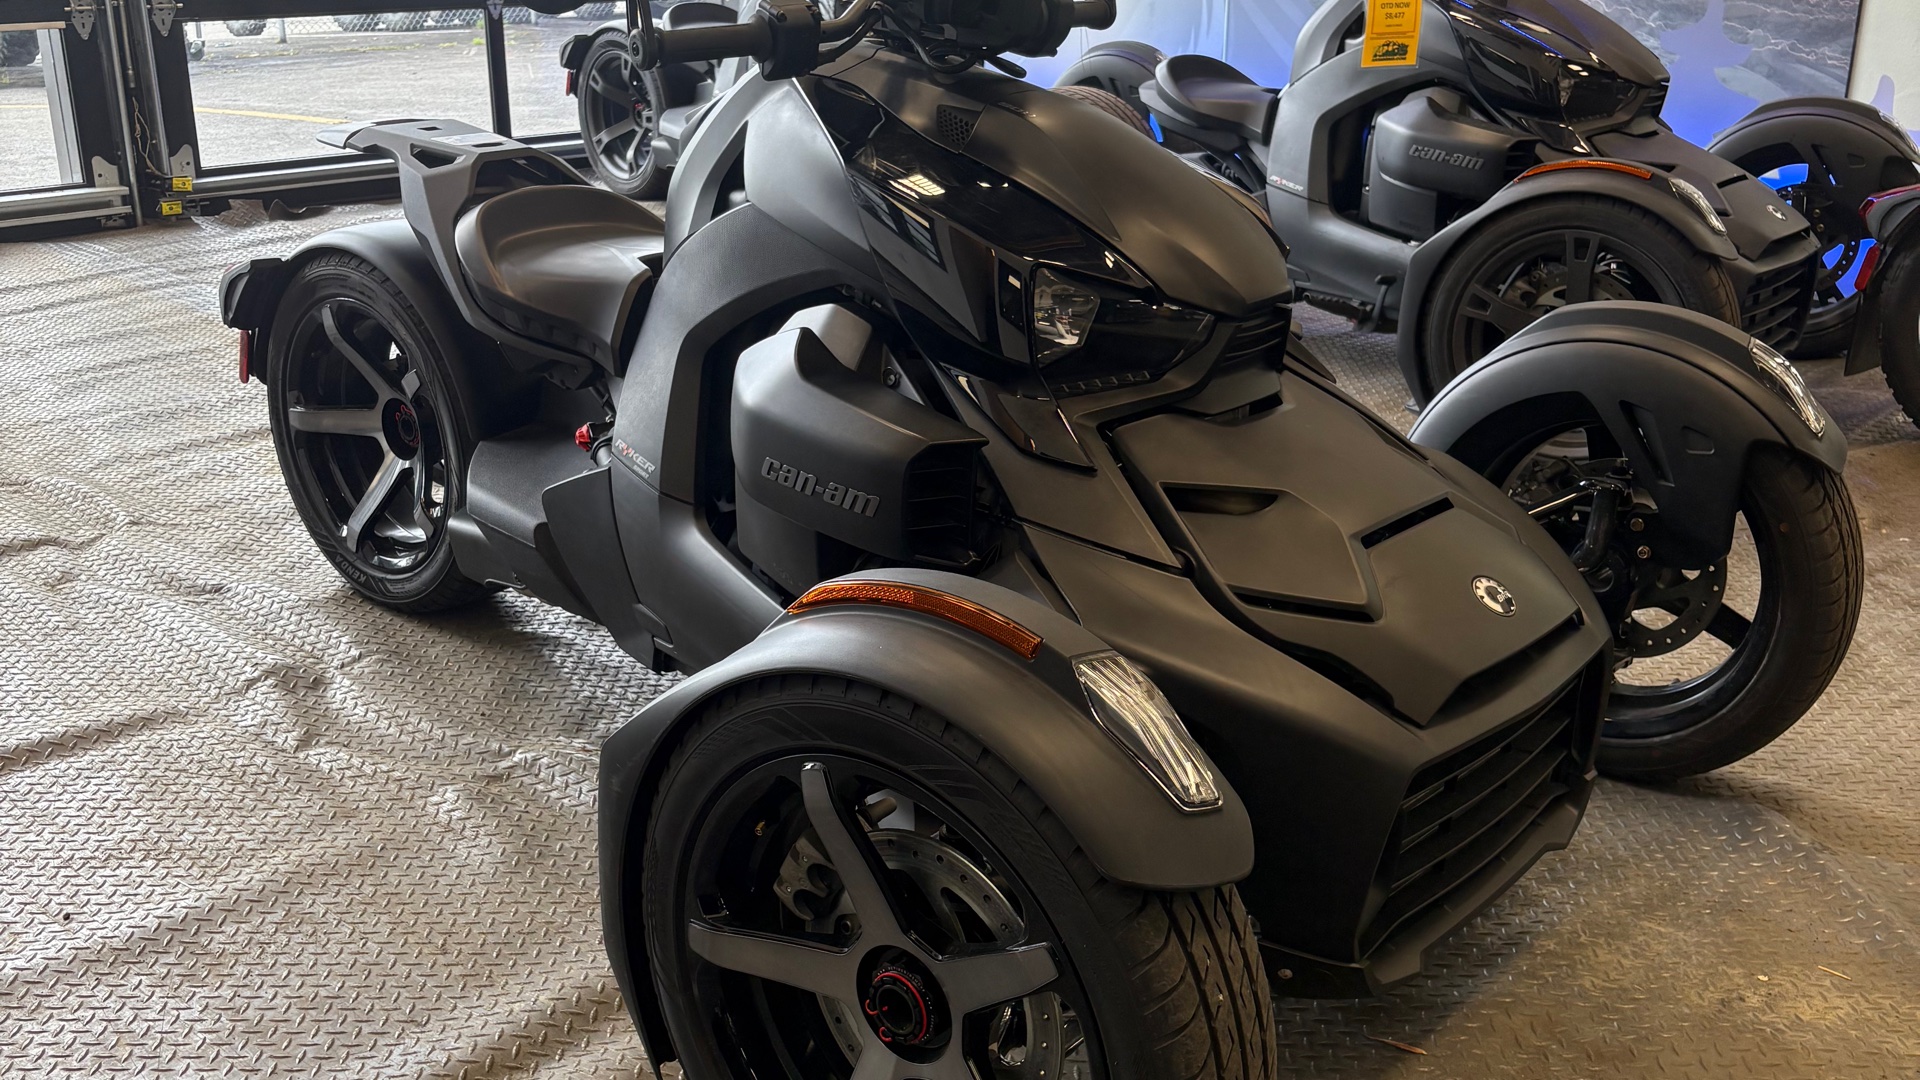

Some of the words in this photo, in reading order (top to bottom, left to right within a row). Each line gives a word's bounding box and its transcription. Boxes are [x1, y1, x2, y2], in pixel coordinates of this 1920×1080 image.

[1408, 144, 1485, 170] can-am
[615, 438, 656, 473] RYKER
[761, 456, 880, 518] can-am
[335, 554, 367, 584] KENDA
